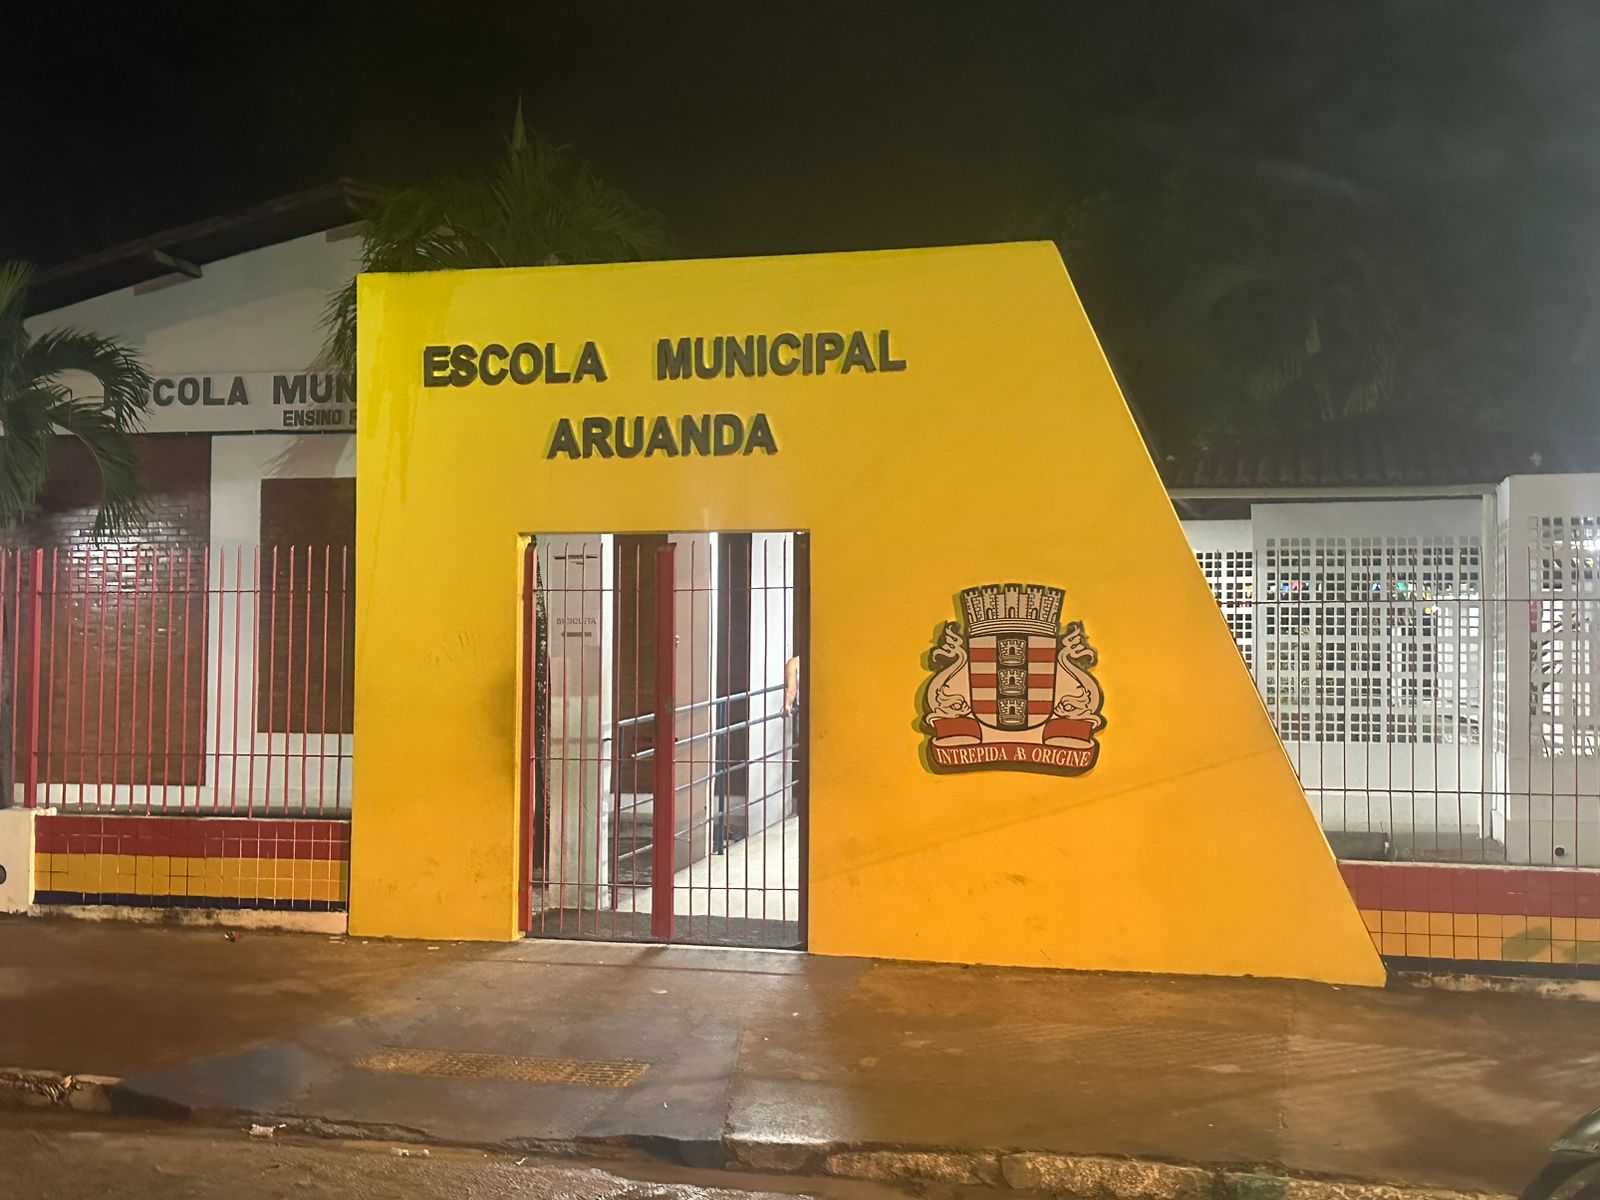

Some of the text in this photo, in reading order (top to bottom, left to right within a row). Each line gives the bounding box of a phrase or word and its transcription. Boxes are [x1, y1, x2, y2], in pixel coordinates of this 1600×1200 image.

[422, 329, 907, 388] ESCOLA MUNICIPAL
[282, 409, 342, 427] ENSINO
[546, 413, 779, 460] ARUANDA
[937, 746, 1007, 766] INTREPIDA
[1031, 747, 1091, 768] ORIGINE
